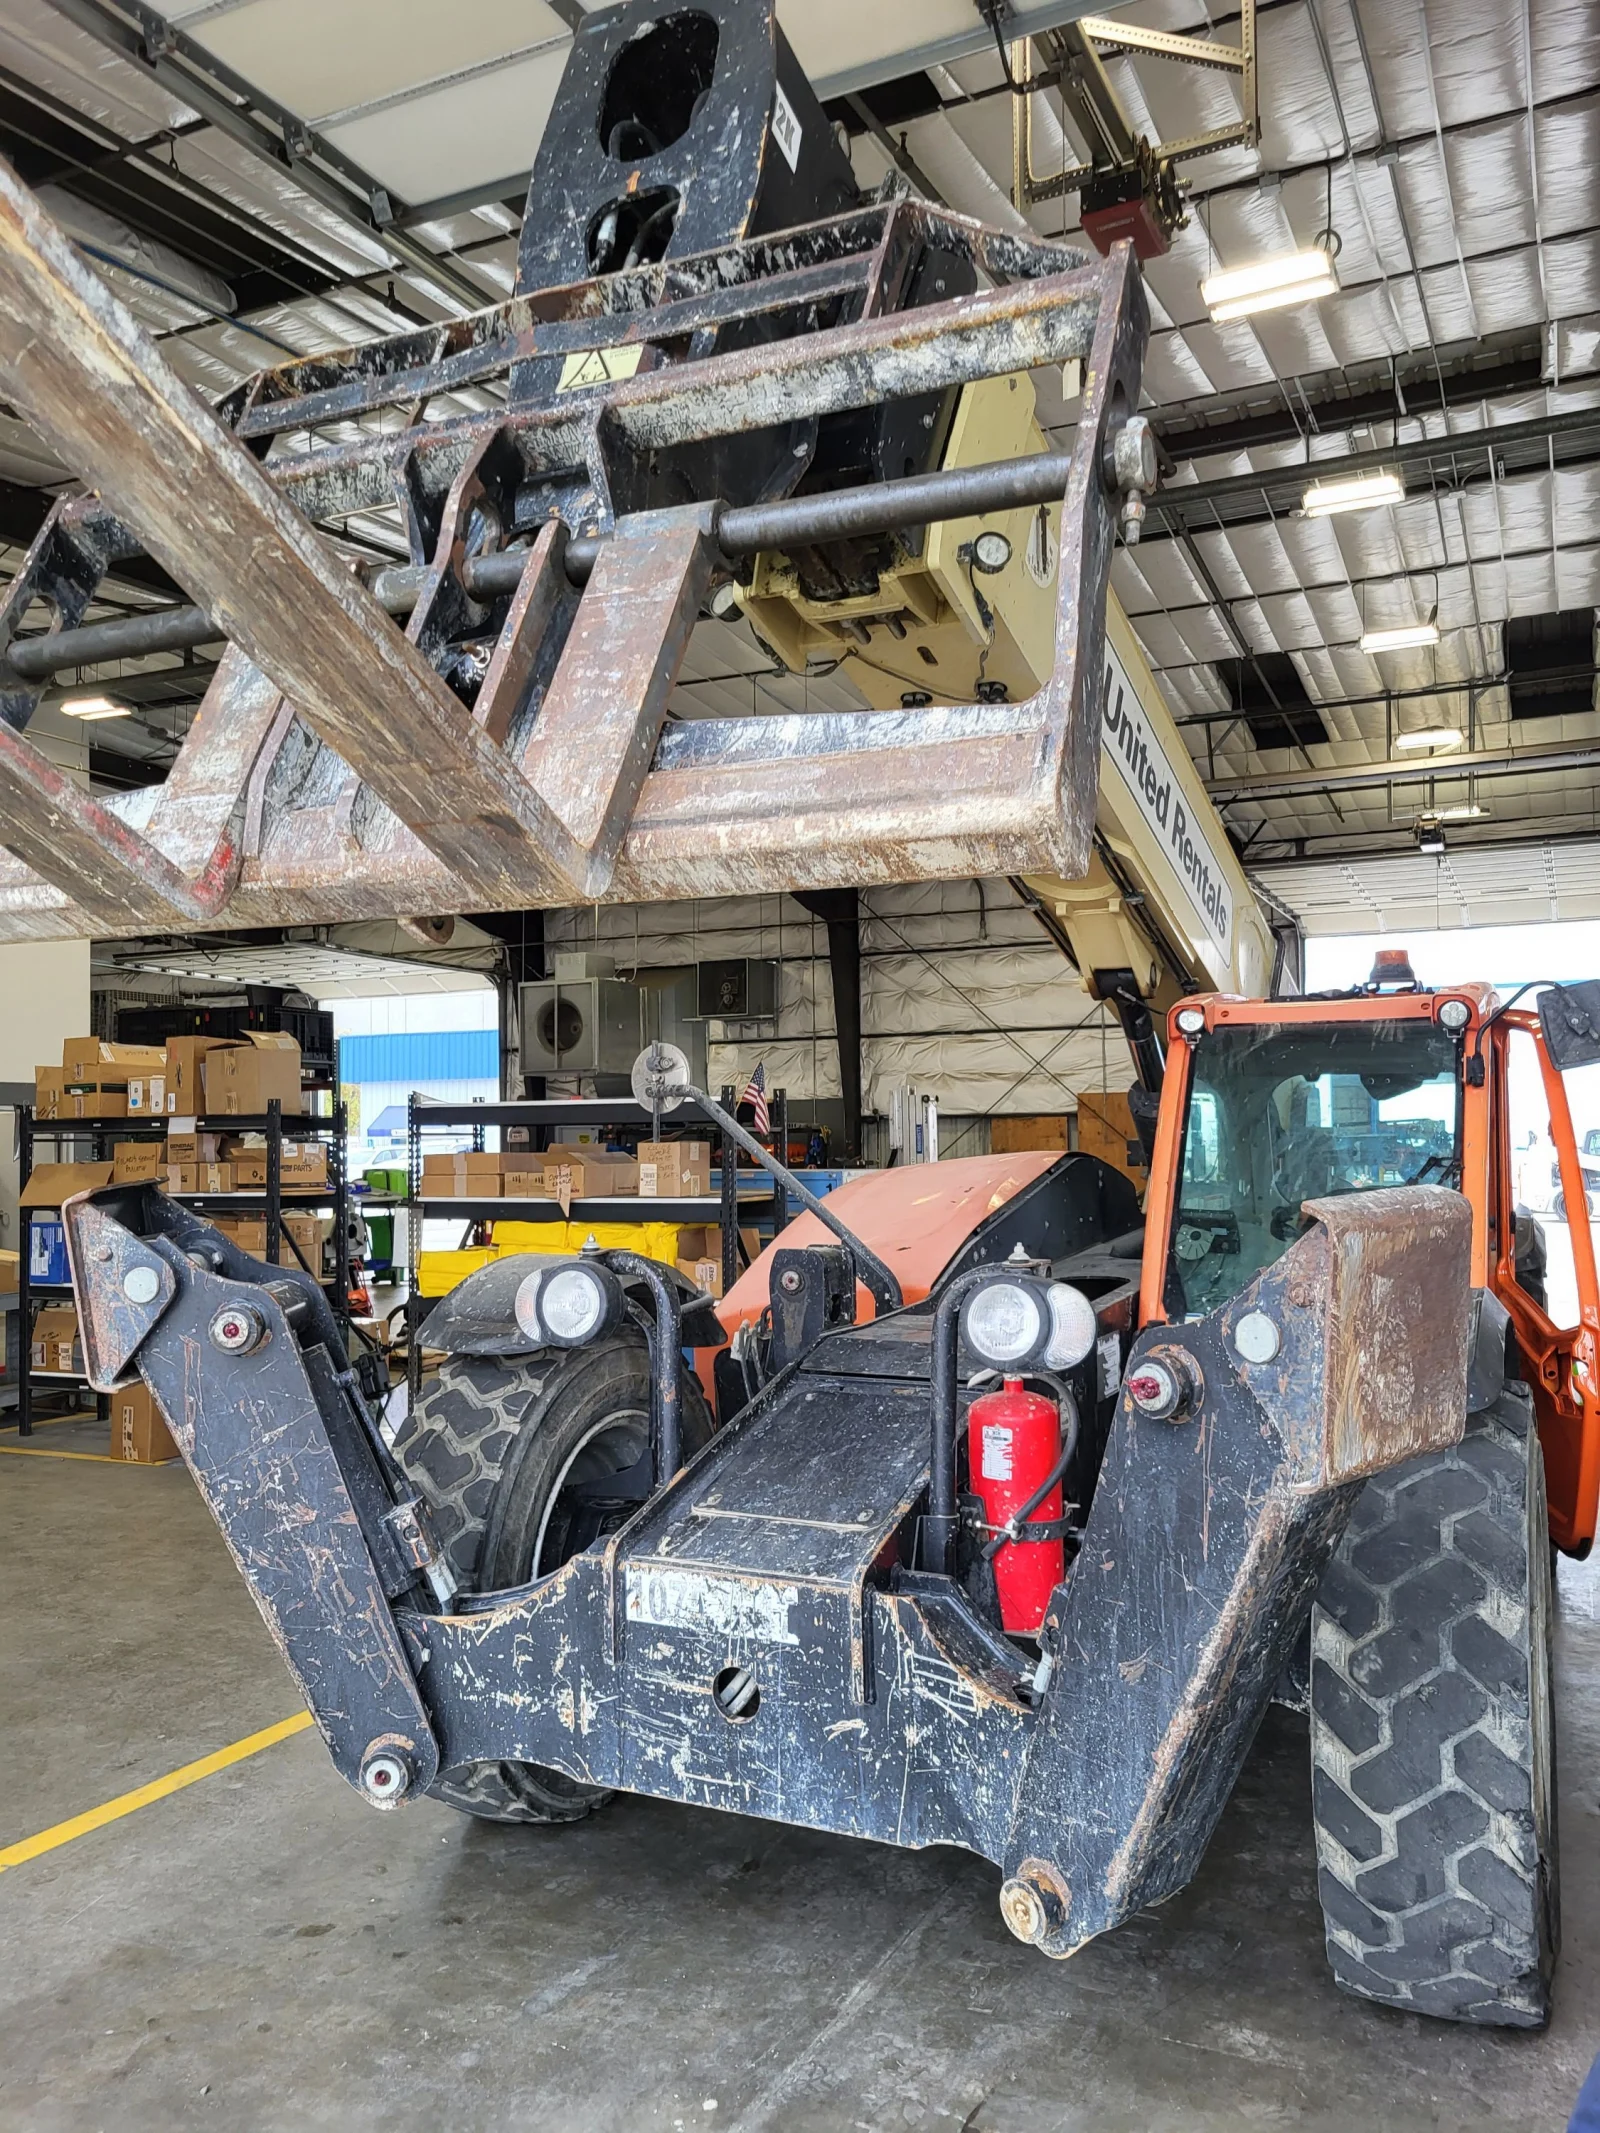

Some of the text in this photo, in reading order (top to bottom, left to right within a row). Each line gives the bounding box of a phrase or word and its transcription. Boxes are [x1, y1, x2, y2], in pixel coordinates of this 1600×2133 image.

[1102, 663, 1228, 939] United Rentals
[293, 1164, 312, 1172] PARTS
